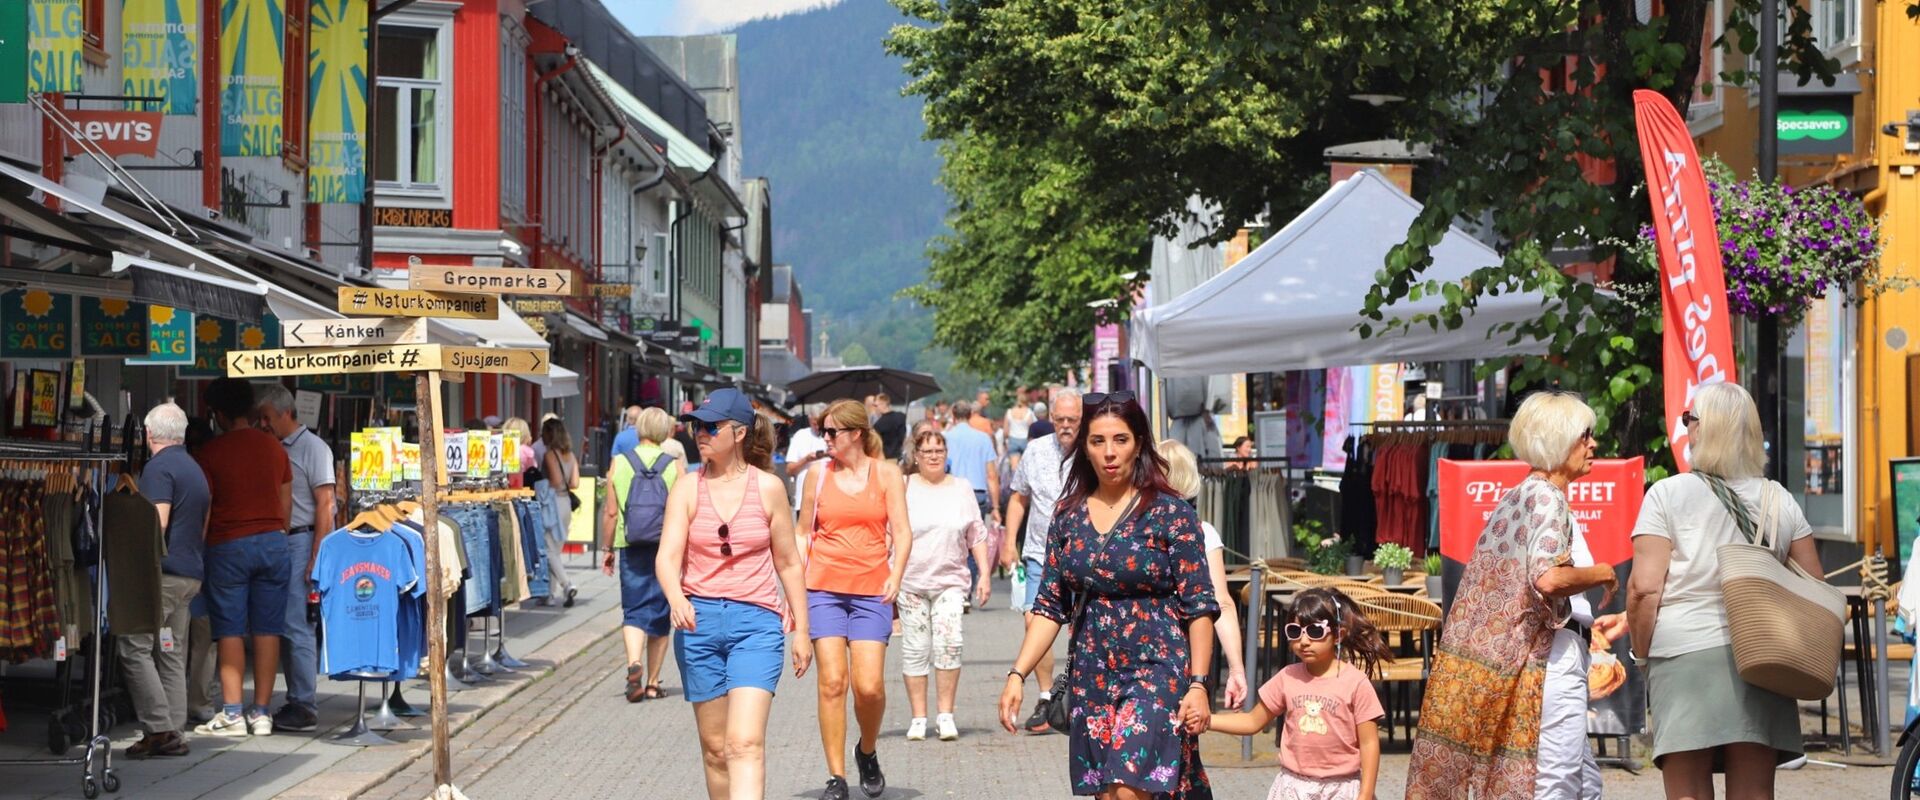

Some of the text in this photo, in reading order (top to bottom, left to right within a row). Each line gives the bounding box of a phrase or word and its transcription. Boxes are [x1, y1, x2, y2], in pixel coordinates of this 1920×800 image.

[28, 3, 82, 38] ALG
[1777, 119, 1841, 132] Specsavers
[444, 271, 548, 289] Gropmarka
[375, 293, 487, 313] Naturkompaniet
[151, 330, 185, 338] MMER
[325, 324, 385, 338] Kånken
[151, 340, 186, 354] ALG
[254, 350, 395, 369] Naturkompaniet
[452, 351, 509, 369] Sjusjøen
[1466, 481, 1616, 503] Piz FFET
[1315, 695, 1340, 716] YORK
